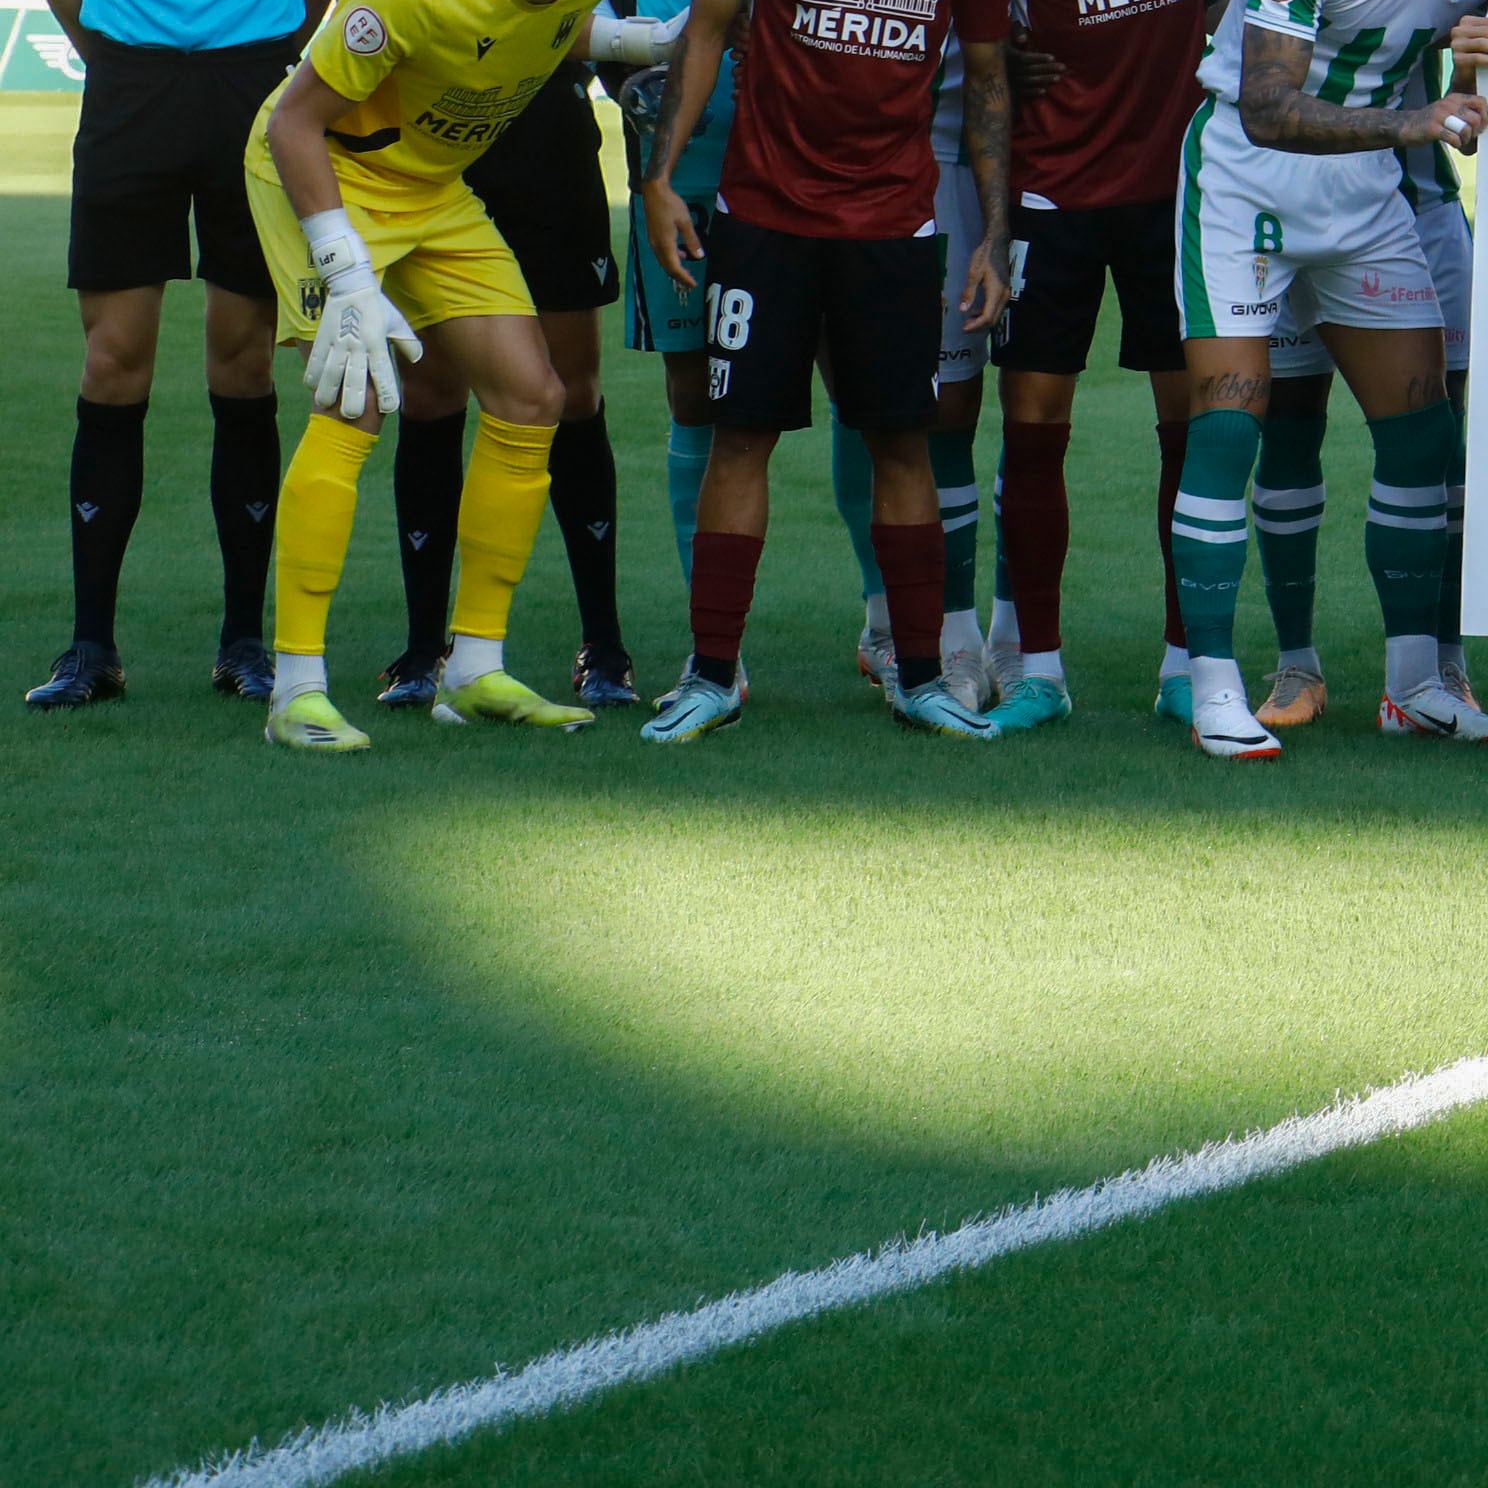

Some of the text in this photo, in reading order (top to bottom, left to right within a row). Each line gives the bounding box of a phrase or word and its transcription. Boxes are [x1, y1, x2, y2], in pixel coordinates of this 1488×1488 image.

[791, 3, 926, 52] MÉRIDA
[1078, 6, 1138, 27] PATRIMONIO
[1139, 3, 1153, 13] DE
[844, 44, 857, 55] DE
[858, 46, 872, 57] LA
[872, 48, 926, 62] HUMANIDAD
[1254, 211, 1283, 254] 8
[705, 282, 754, 351] 18
[1231, 302, 1278, 316] GIVOVA
